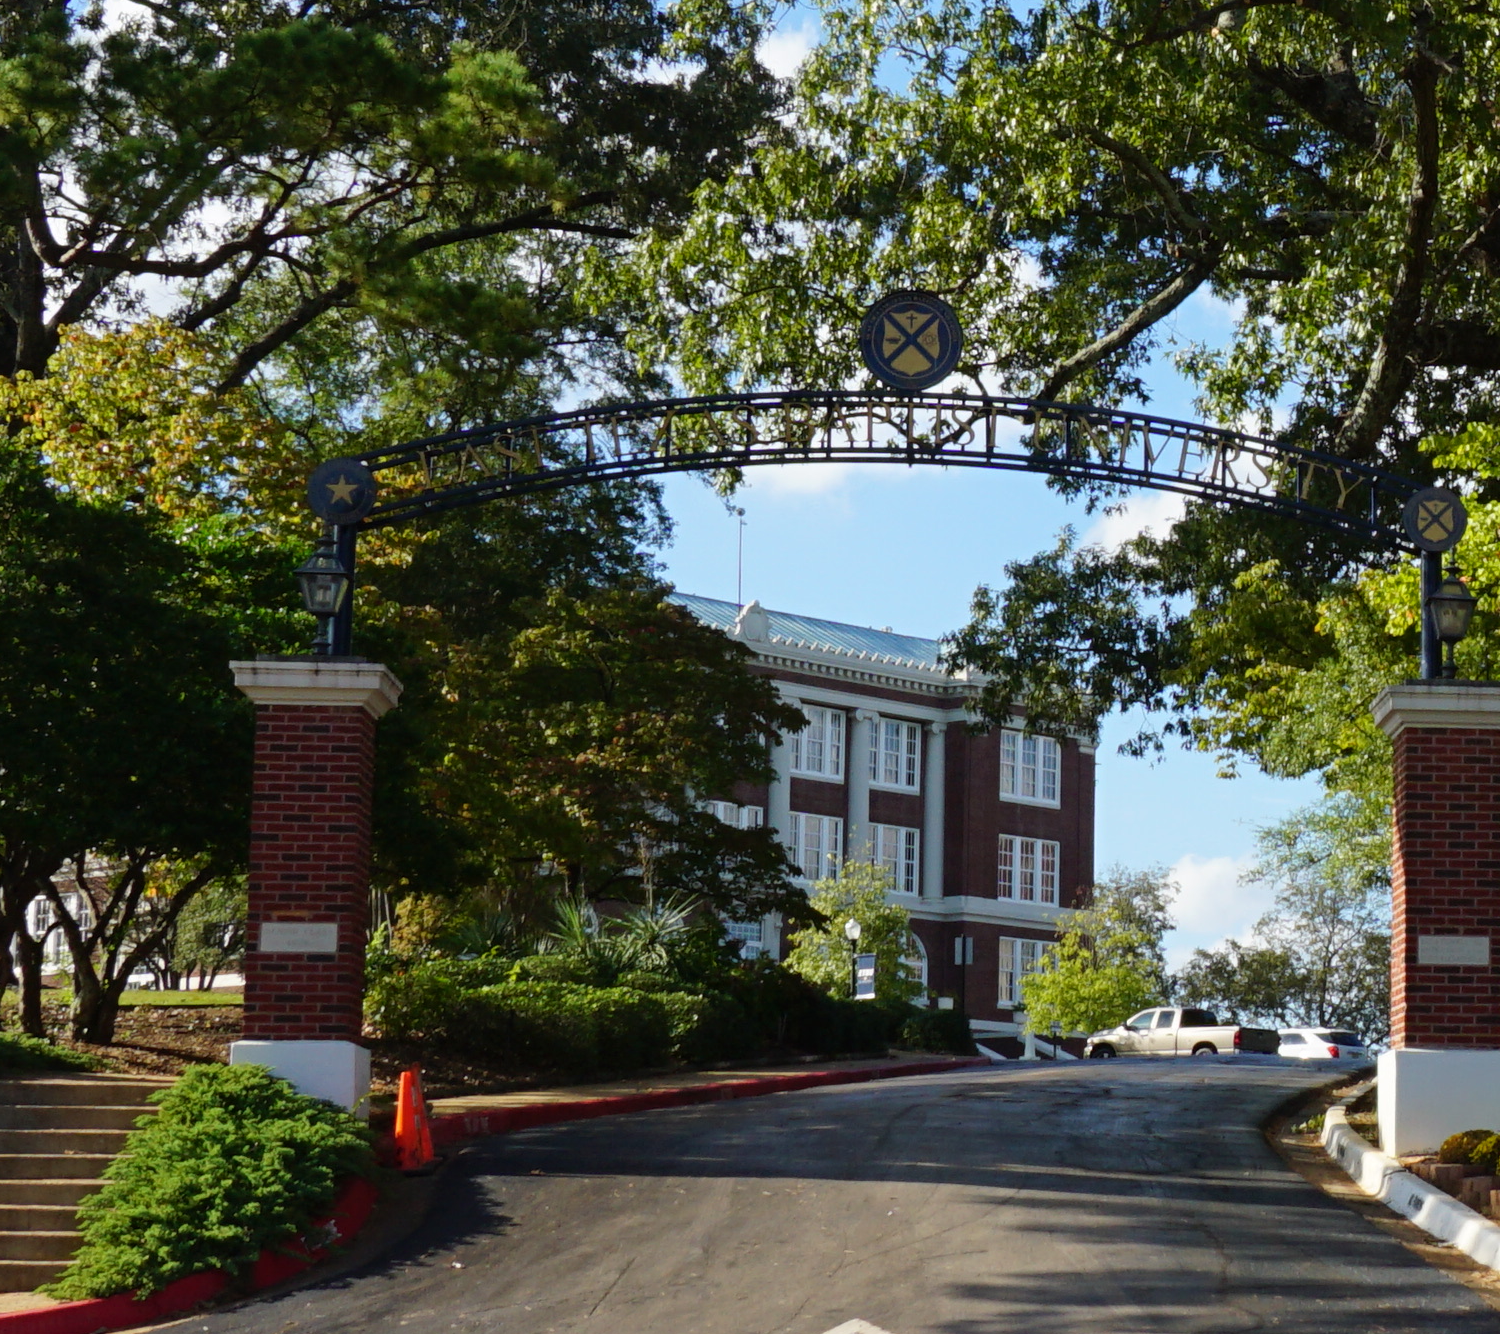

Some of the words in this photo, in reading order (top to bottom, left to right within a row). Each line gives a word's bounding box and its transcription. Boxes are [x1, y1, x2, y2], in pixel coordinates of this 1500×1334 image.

[418, 424, 550, 490] EAST
[570, 404, 759, 461] TEXAS
[782, 401, 1012, 448] BAPTIST
[1030, 409, 1366, 510] UNIVERSITY
